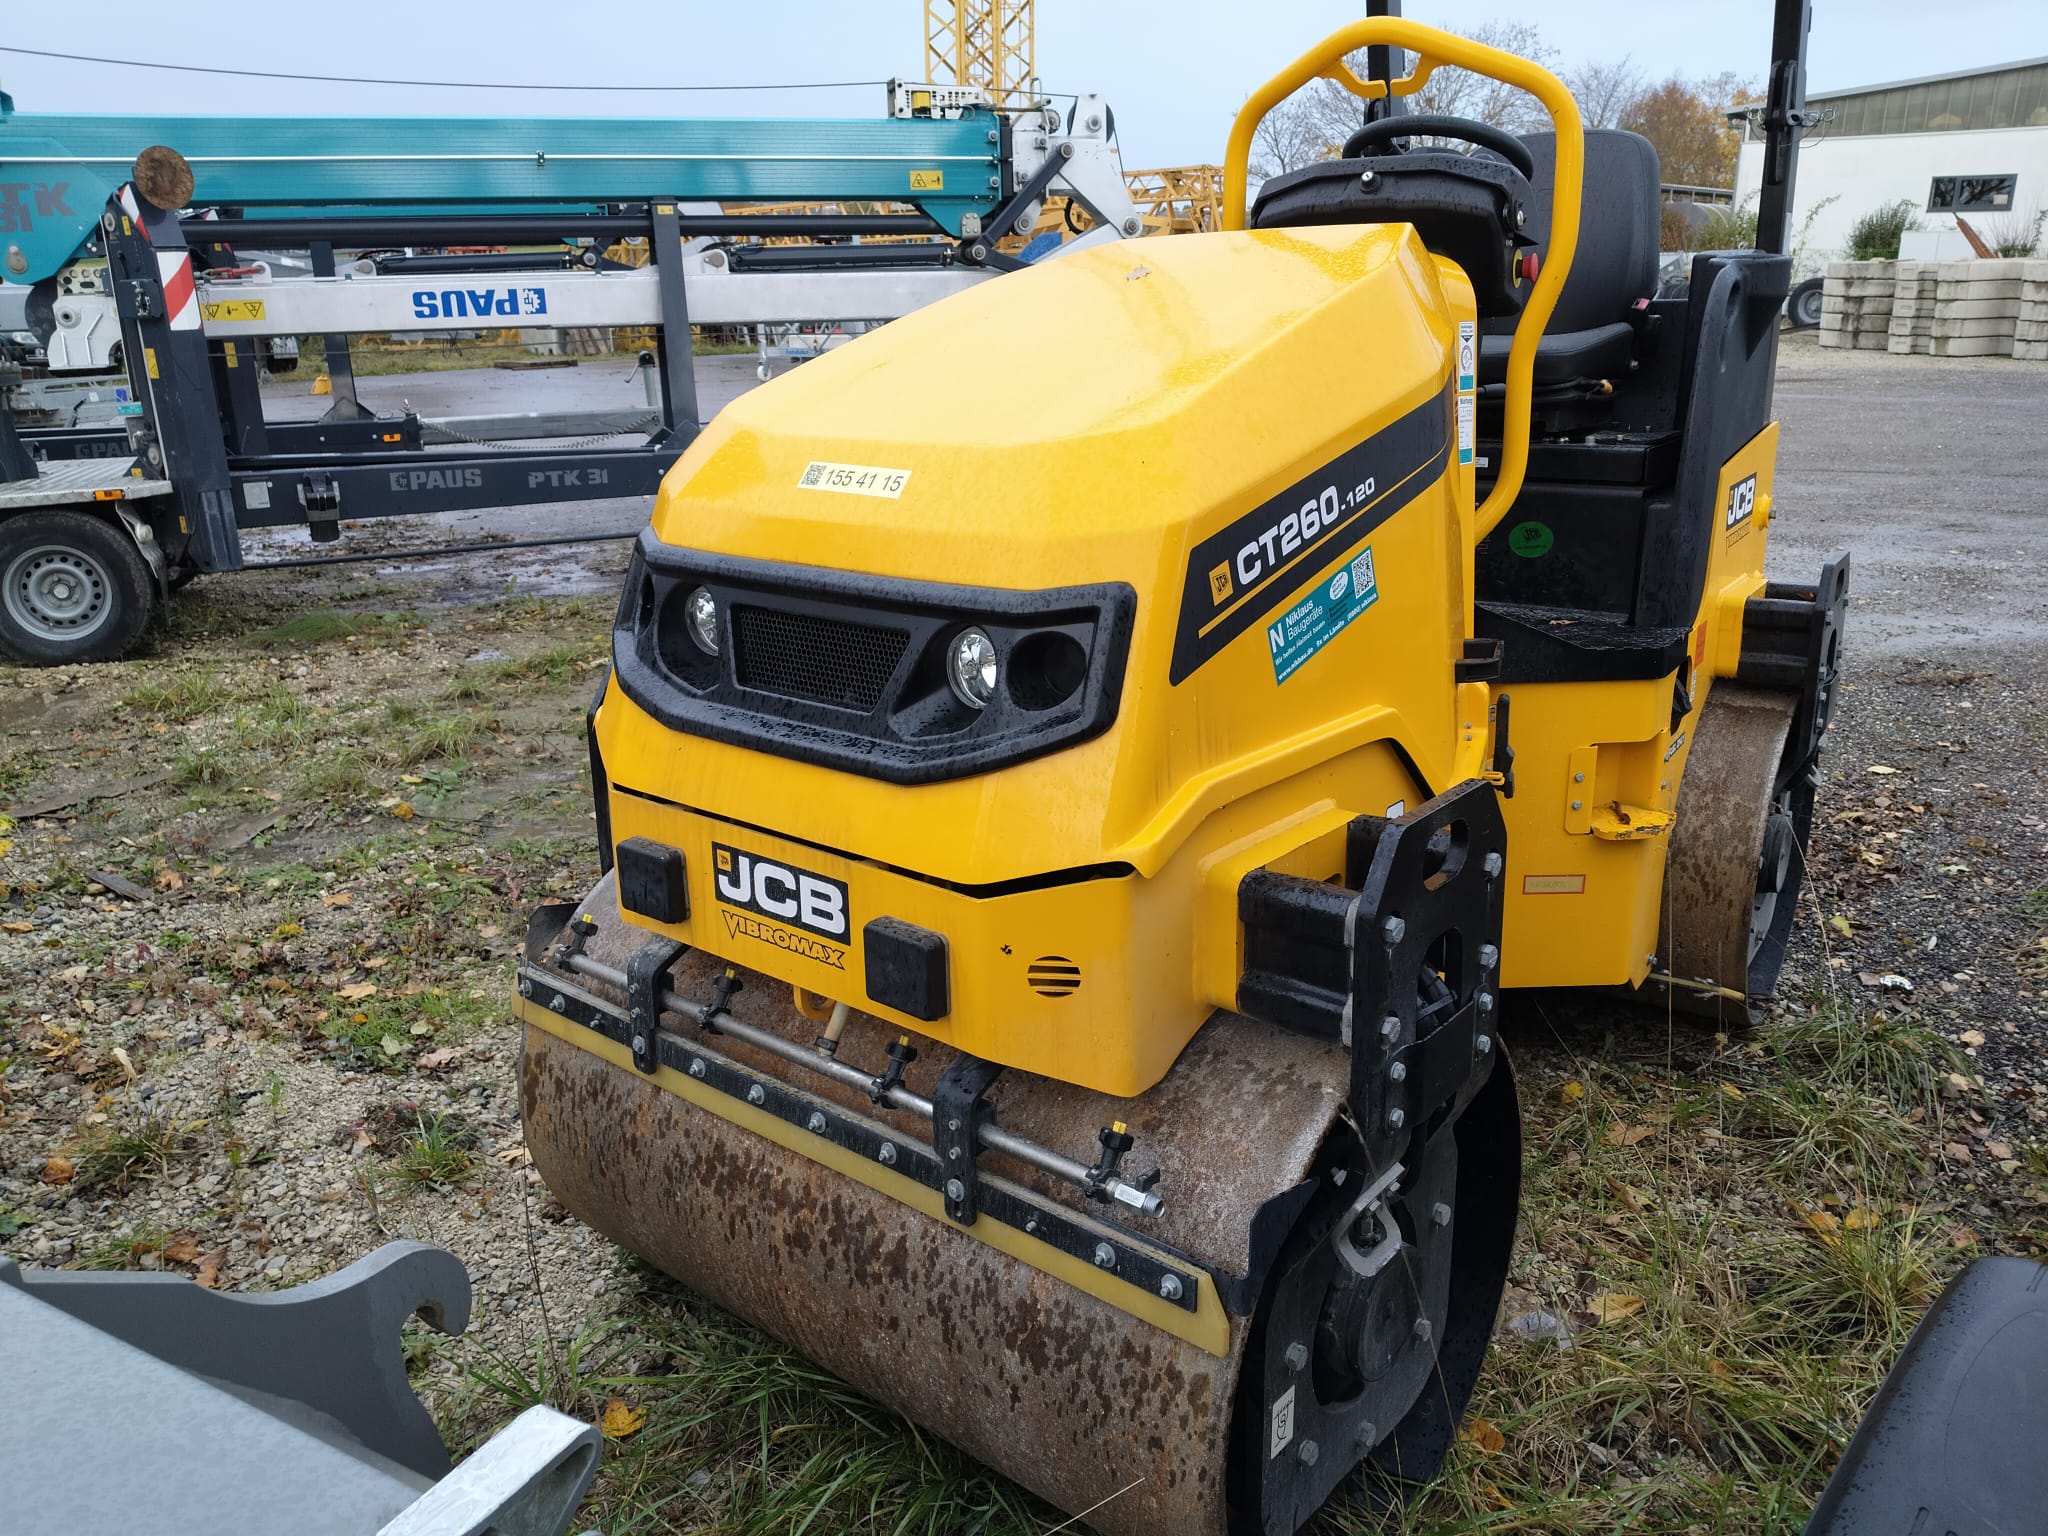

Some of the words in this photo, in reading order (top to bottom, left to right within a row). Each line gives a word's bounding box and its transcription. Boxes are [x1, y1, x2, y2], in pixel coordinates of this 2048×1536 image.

[0, 182, 77, 216] TK
[412, 288, 520, 318] PAUS
[91, 443, 132, 458] PAU
[410, 469, 482, 490] PAUS
[528, 469, 582, 488] PTK
[587, 468, 608, 485] 31
[826, 468, 855, 486] 155
[856, 472, 878, 489] 41
[883, 474, 904, 492] 15
[1728, 478, 1756, 526] JCB
[1269, 622, 1285, 653] N
[1285, 600, 1314, 628] Niklaus
[1287, 606, 1323, 640] Baugeräte
[718, 855, 845, 934] JCB
[721, 909, 846, 971] VIBROMAX
